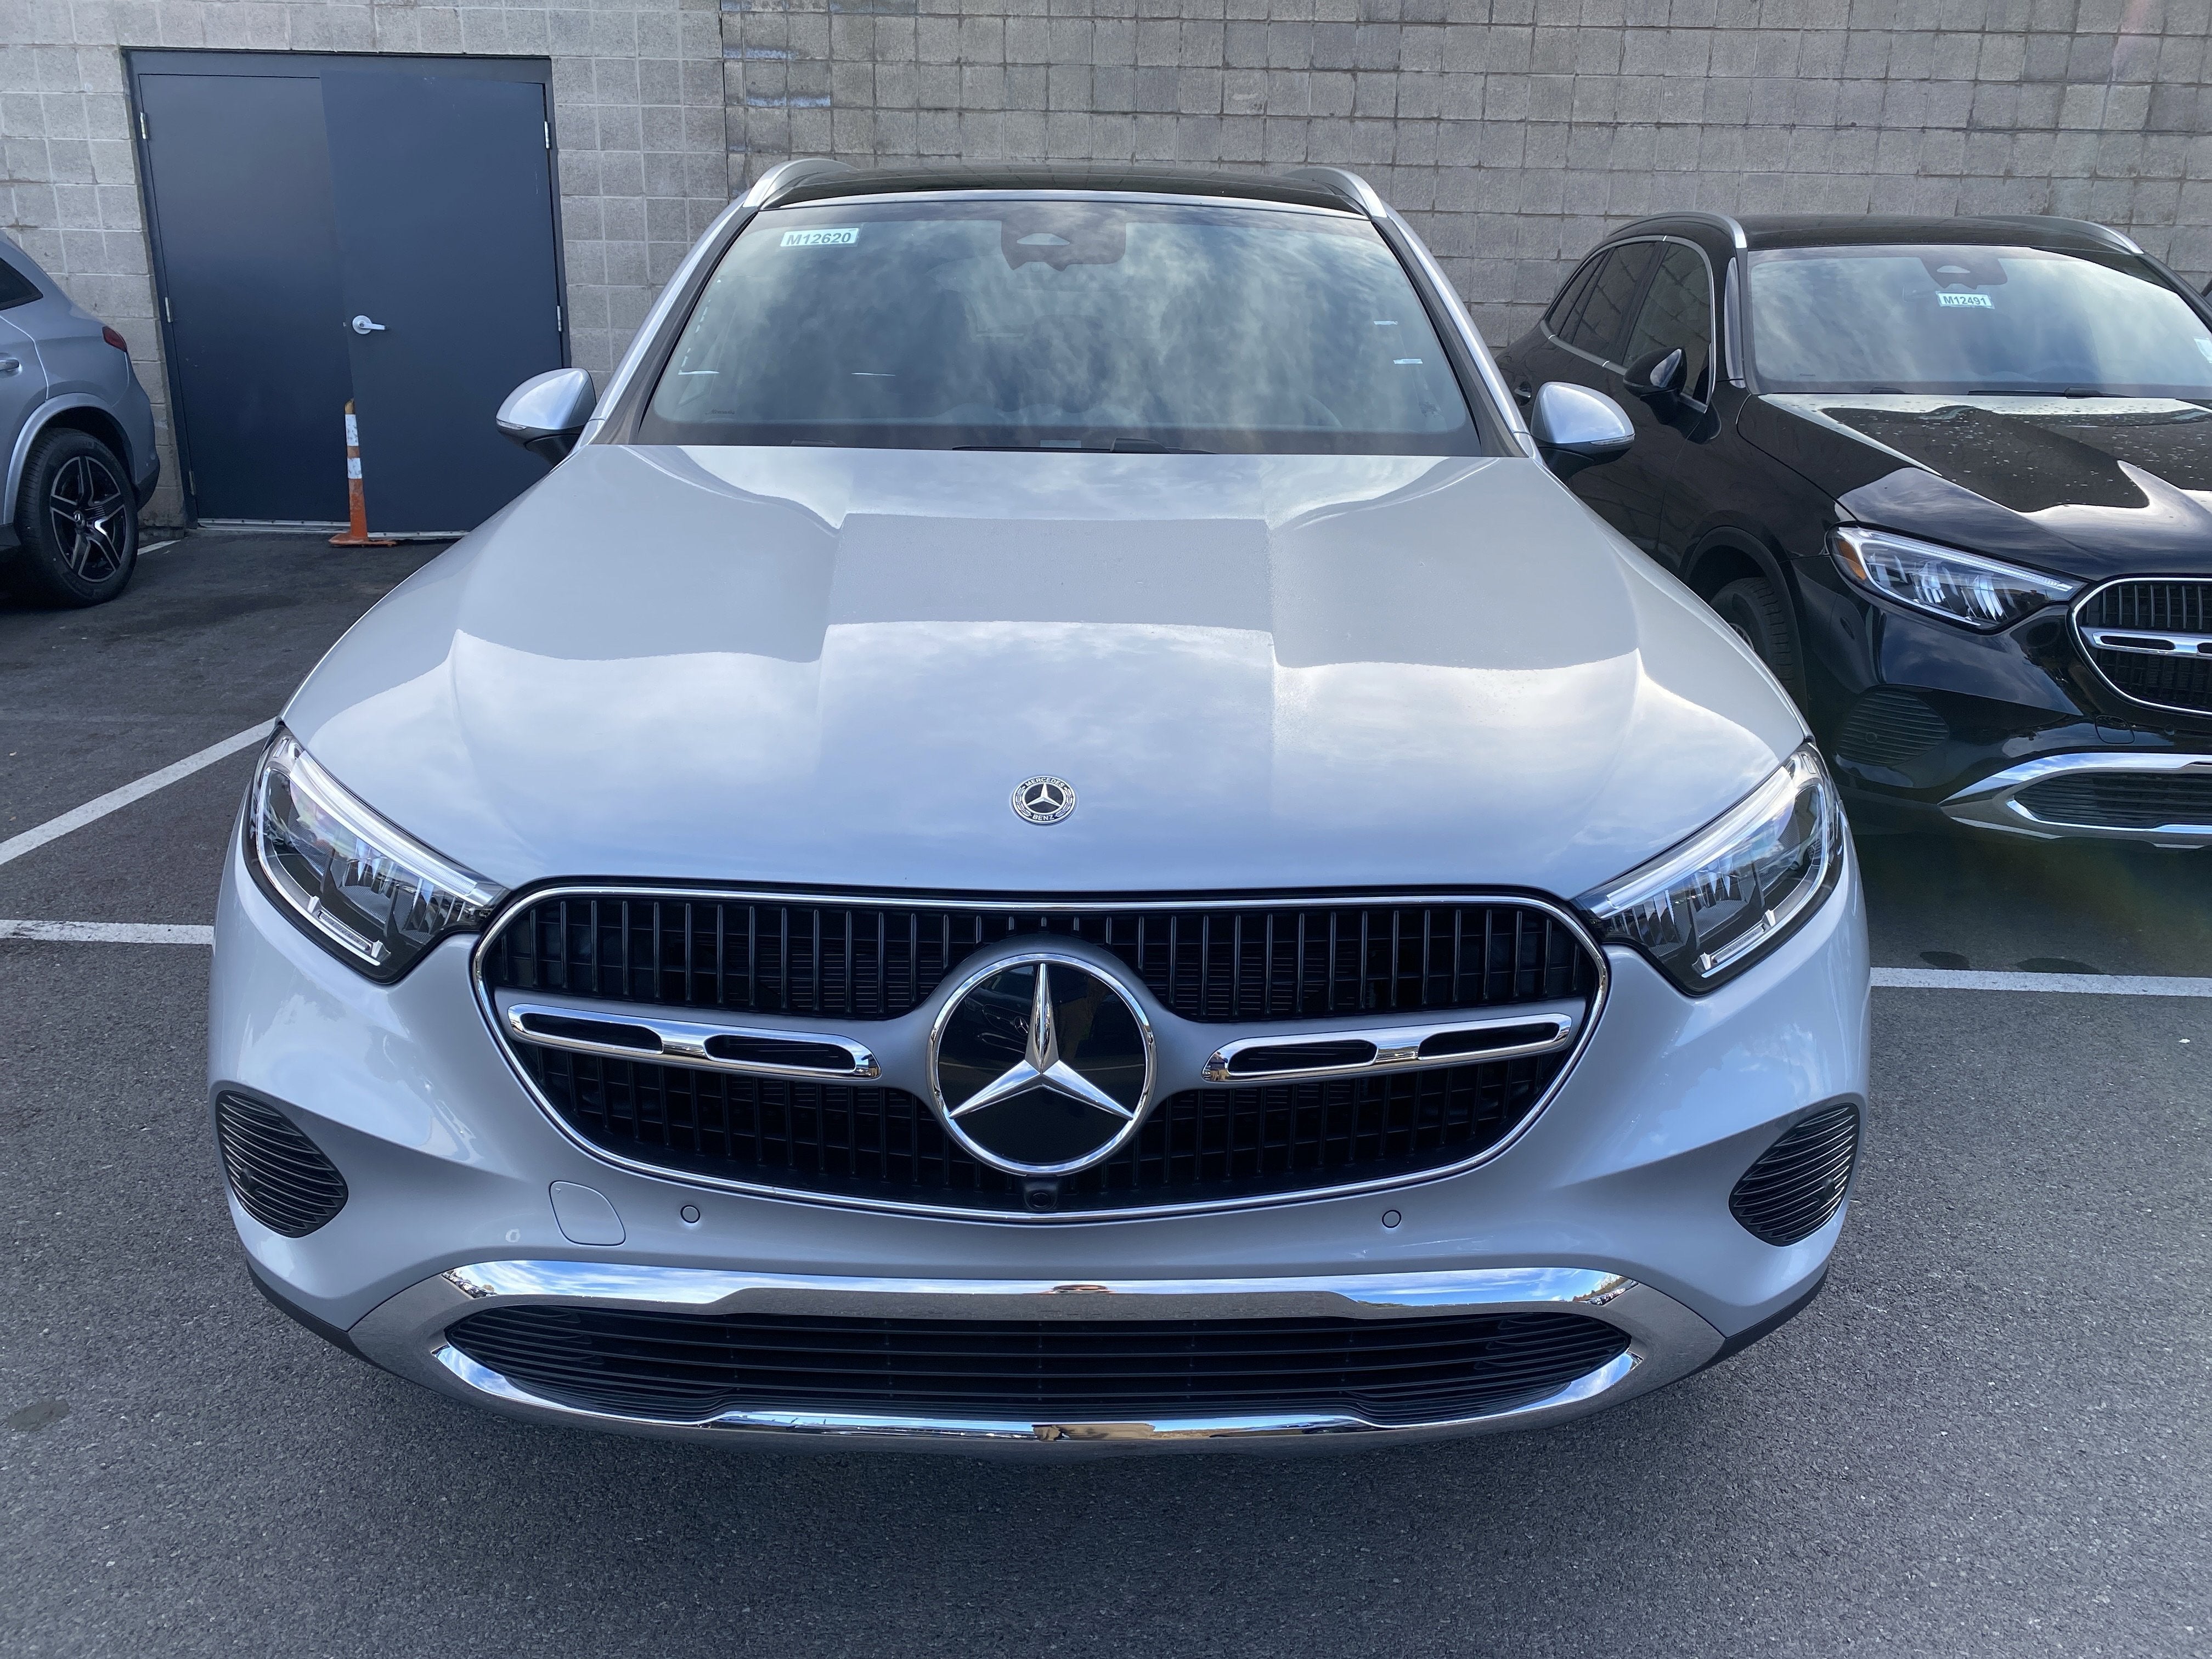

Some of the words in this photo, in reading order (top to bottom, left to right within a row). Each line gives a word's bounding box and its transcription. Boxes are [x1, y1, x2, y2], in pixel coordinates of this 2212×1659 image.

[786, 232, 851, 245] M12620
[1943, 296, 1987, 305] M12491
[1025, 777, 1065, 787] MERCEDES
